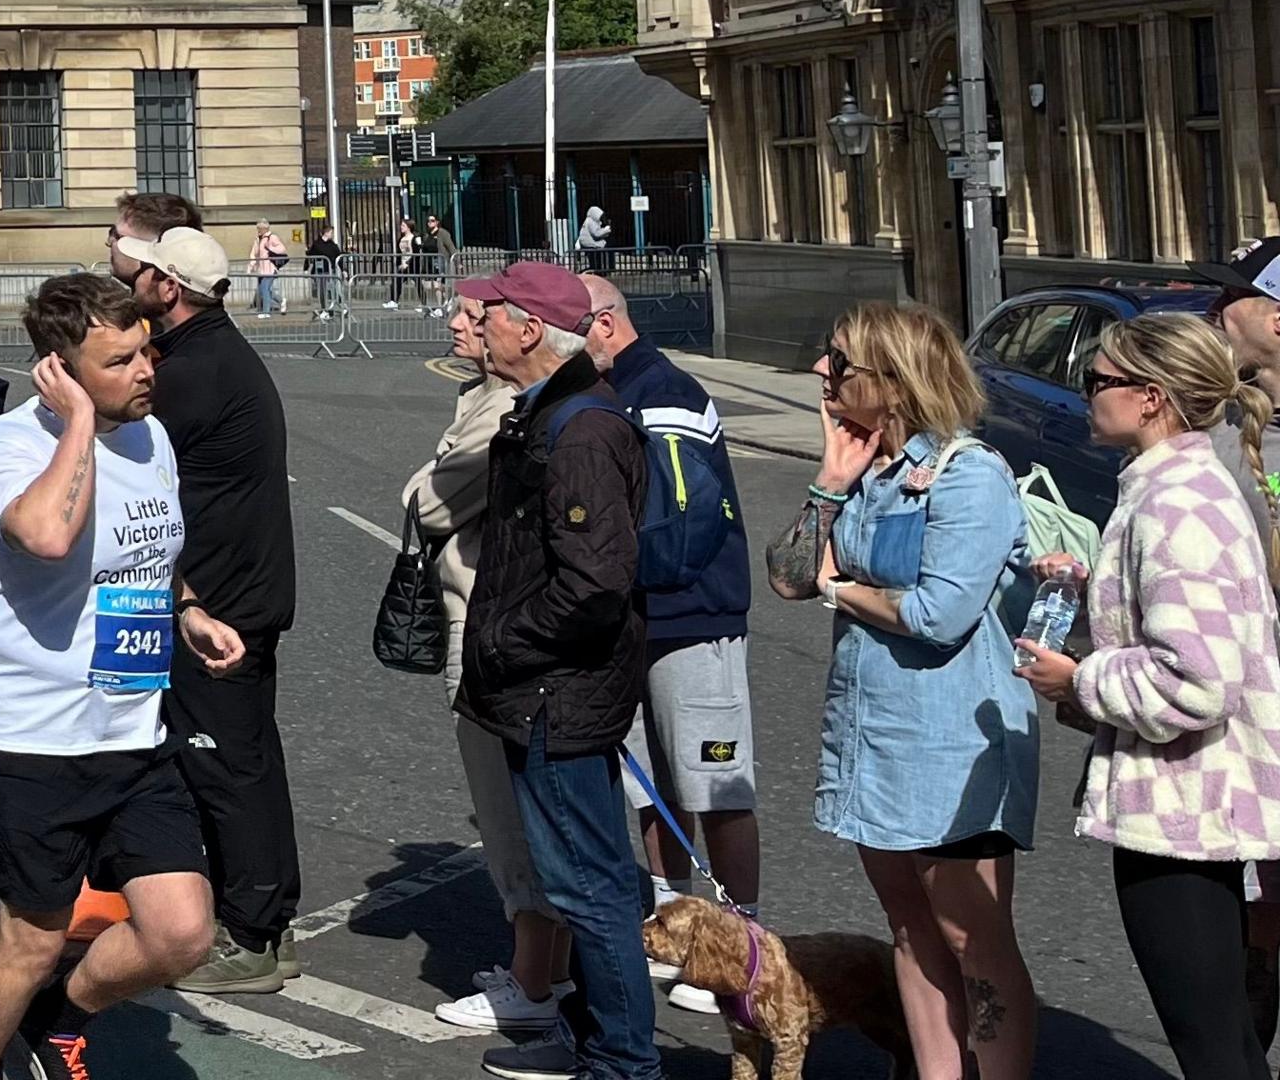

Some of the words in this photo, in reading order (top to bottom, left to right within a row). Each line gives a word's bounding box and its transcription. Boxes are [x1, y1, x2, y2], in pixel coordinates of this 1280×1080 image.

[125, 497, 169, 521] Little
[113, 520, 184, 547] Victories
[149, 544, 167, 559] the
[131, 597, 153, 610] HULL
[114, 628, 161, 655] 2342
